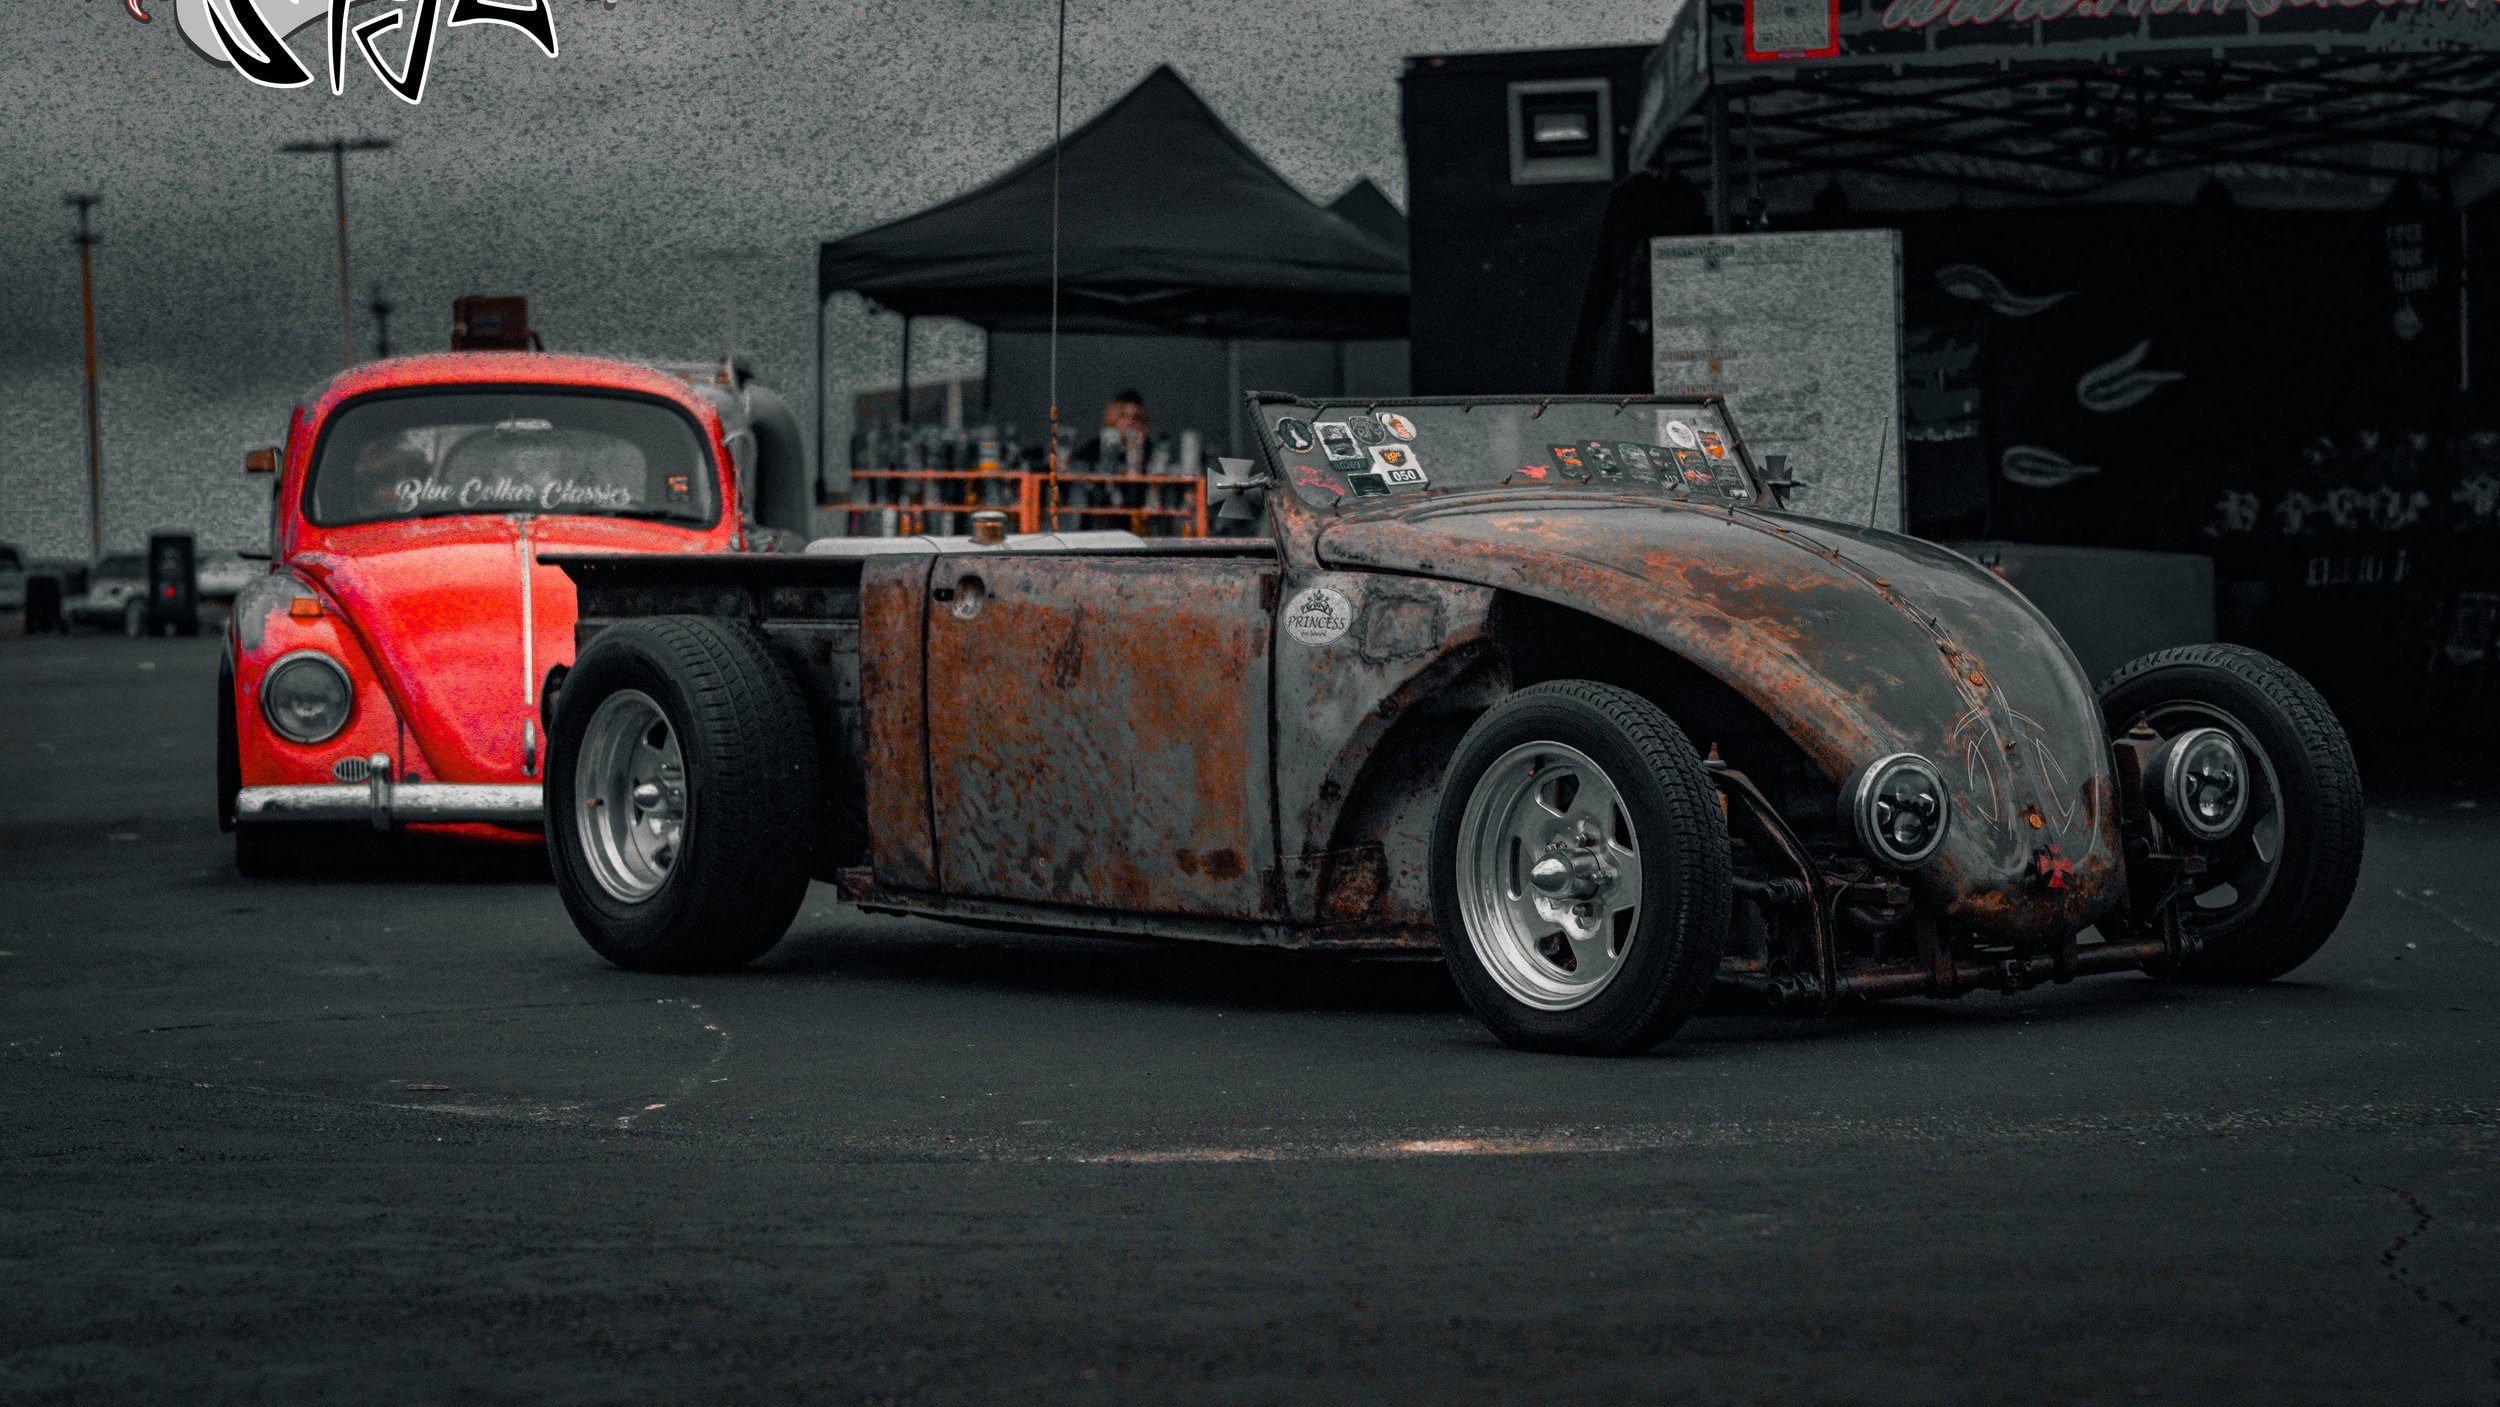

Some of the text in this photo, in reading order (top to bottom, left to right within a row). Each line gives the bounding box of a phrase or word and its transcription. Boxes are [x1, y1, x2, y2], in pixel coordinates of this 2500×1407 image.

[1392, 470, 1417, 482] 050
[395, 477, 631, 513] Blue Collar Classics
[1288, 615, 1347, 630] PRINCESS
